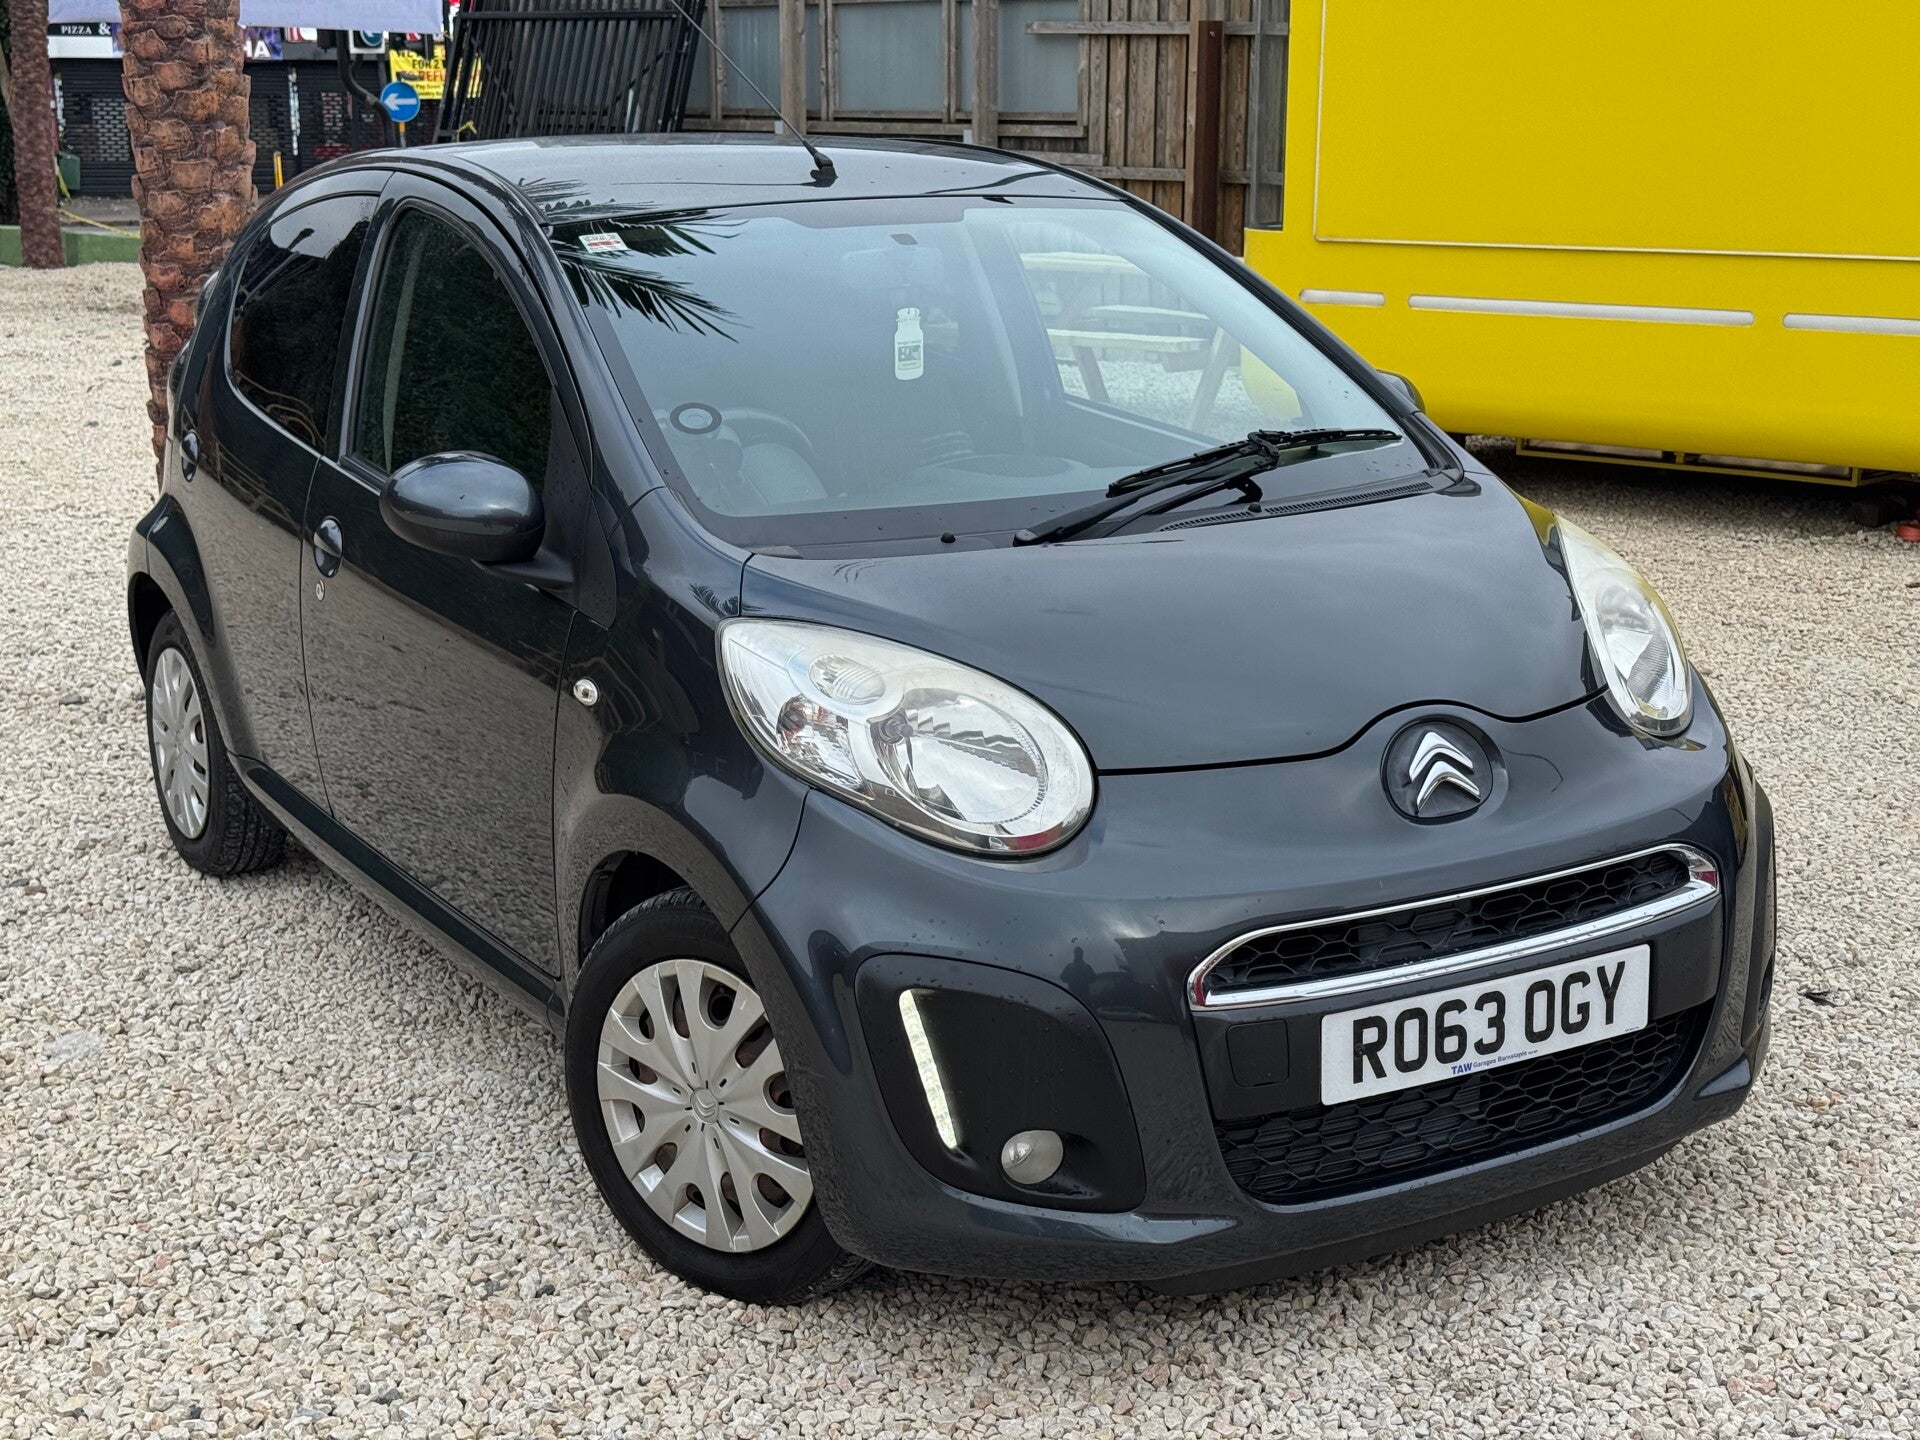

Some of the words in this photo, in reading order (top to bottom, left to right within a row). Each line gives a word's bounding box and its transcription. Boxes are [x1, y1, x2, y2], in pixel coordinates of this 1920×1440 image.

[61, 25, 92, 35] PIZZA
[98, 21, 111, 35] &
[412, 59, 432, 69] FOR
[1353, 990, 1506, 1084] RO63
[1524, 961, 1625, 1043] OGY
[1451, 1062, 1473, 1075] TAW
[1473, 1058, 1496, 1068] Garages
[1498, 1050, 1527, 1062] Barnstaple
